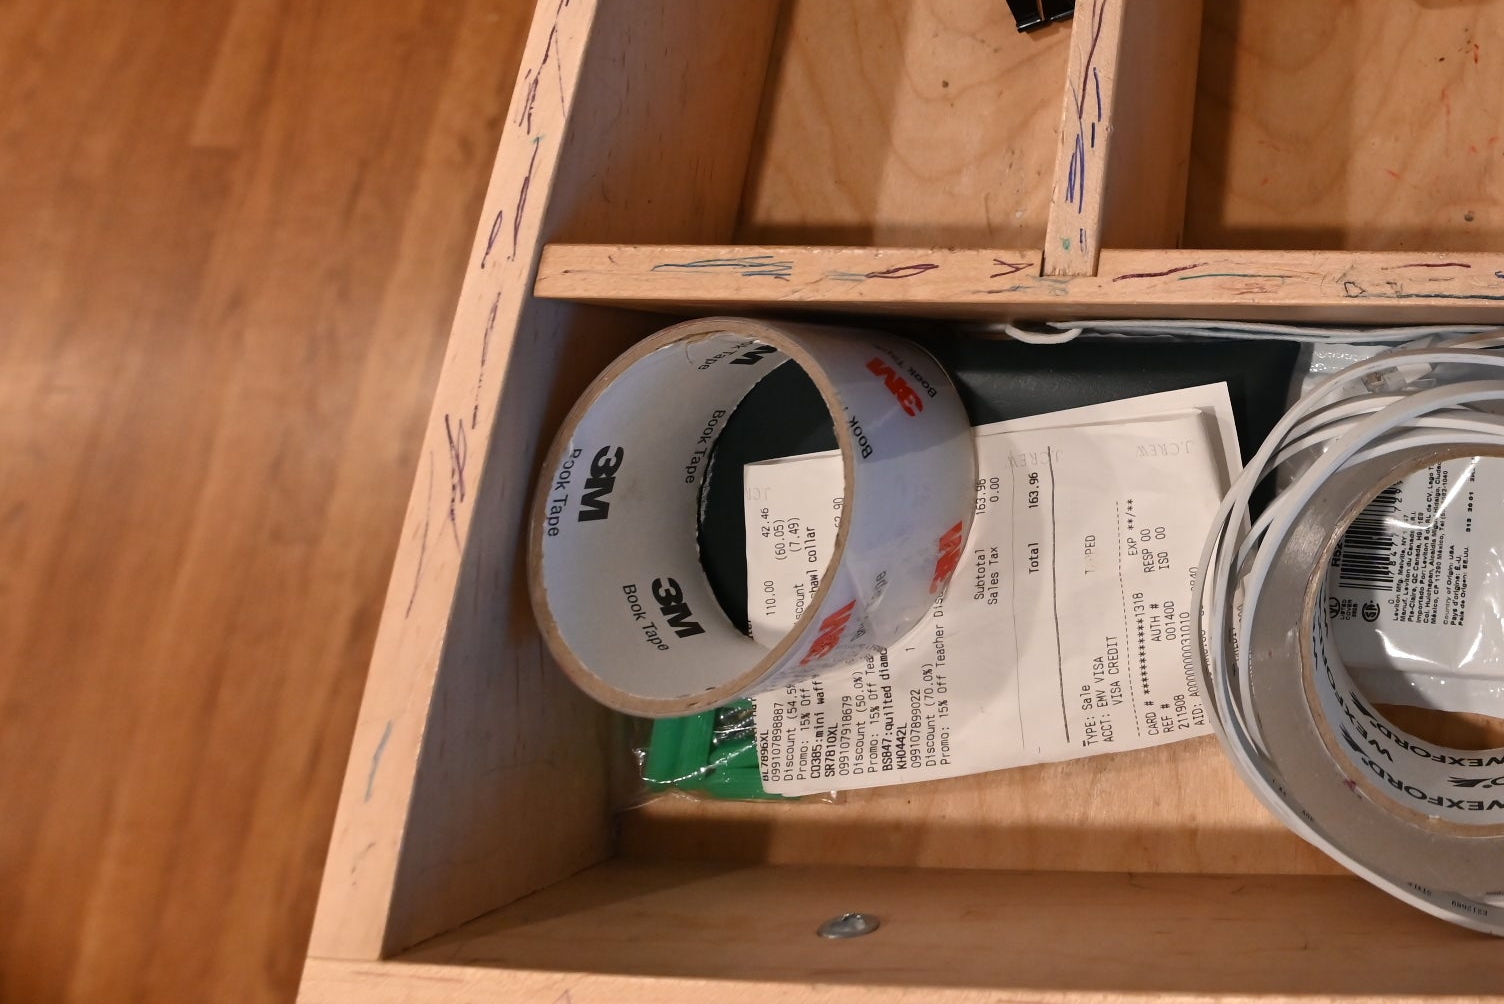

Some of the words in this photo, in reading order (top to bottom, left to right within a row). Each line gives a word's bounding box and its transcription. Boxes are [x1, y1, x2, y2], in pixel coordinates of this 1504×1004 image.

[866, 357, 924, 417] 3M
[907, 365, 938, 398] Book
[698, 410, 726, 445] Book
[848, 415, 873, 459] Book
[685, 446, 708, 485] Tape
[578, 445, 625, 523] 3M
[974, 478, 986, 514] 163.96
[990, 478, 999, 502] 0.00
[1028, 472, 1039, 508] 163.96
[547, 494, 568, 537] Tape
[761, 508, 770, 537] 42.46
[774, 520, 787, 560] (60.05)
[788, 518, 802, 552] (7.49)
[804, 527, 817, 562] collar
[1127, 538, 1138, 555] EXP
[1140, 529, 1151, 542] 00
[1155, 527, 1166, 539] 00
[989, 547, 998, 566] Tax
[1028, 543, 1038, 573] Total
[1142, 549, 1155, 572] RESP
[1157, 552, 1169, 570] ISO
[974, 550, 985, 599] Subtotal
[988, 572, 999, 604] Sales
[651, 577, 706, 639] 3M
[764, 581, 776, 615] 110.00
[623, 584, 647, 621] Book
[642, 621, 669, 651] Tape
[1150, 616, 1161, 641] AUTH
[933, 625, 945, 667] Teacher
[1106, 636, 1119, 674] CREDIT
[922, 664, 935, 706] (70.0%)
[937, 676, 947, 693] Off
[1093, 657, 1104, 683] VISA
[800, 689, 810, 706] Off
[853, 670, 867, 712] (50.0%)
[867, 683, 878, 700] Off
[1080, 685, 1092, 710] Sale
[1096, 690, 1108, 707] EMV
[1110, 681, 1123, 705] VISA
[800, 713, 810, 730] 15%
[870, 706, 880, 724] 15%
[938, 700, 948, 718] 15%
[1146, 712, 1159, 735] CARD
[1161, 716, 1174, 733] REF
[1174, 695, 1189, 729] 211908
[1192, 704, 1204, 725] AID:
[772, 703, 786, 781] 099107898887
[837, 696, 854, 775] 099107918679
[880, 686, 896, 771] BS847:quilted
[910, 689, 921, 768] 099107899022
[925, 715, 936, 766] Discount
[1085, 717, 1098, 746] TYPE:
[1100, 714, 1114, 742] ACCT:
[784, 728, 798, 781] Discount
[797, 741, 810, 780] Promo:
[823, 723, 840, 777] SR7810XL
[854, 721, 865, 774] Discount
[868, 734, 878, 772] Promo:
[940, 728, 950, 764] Promo:
